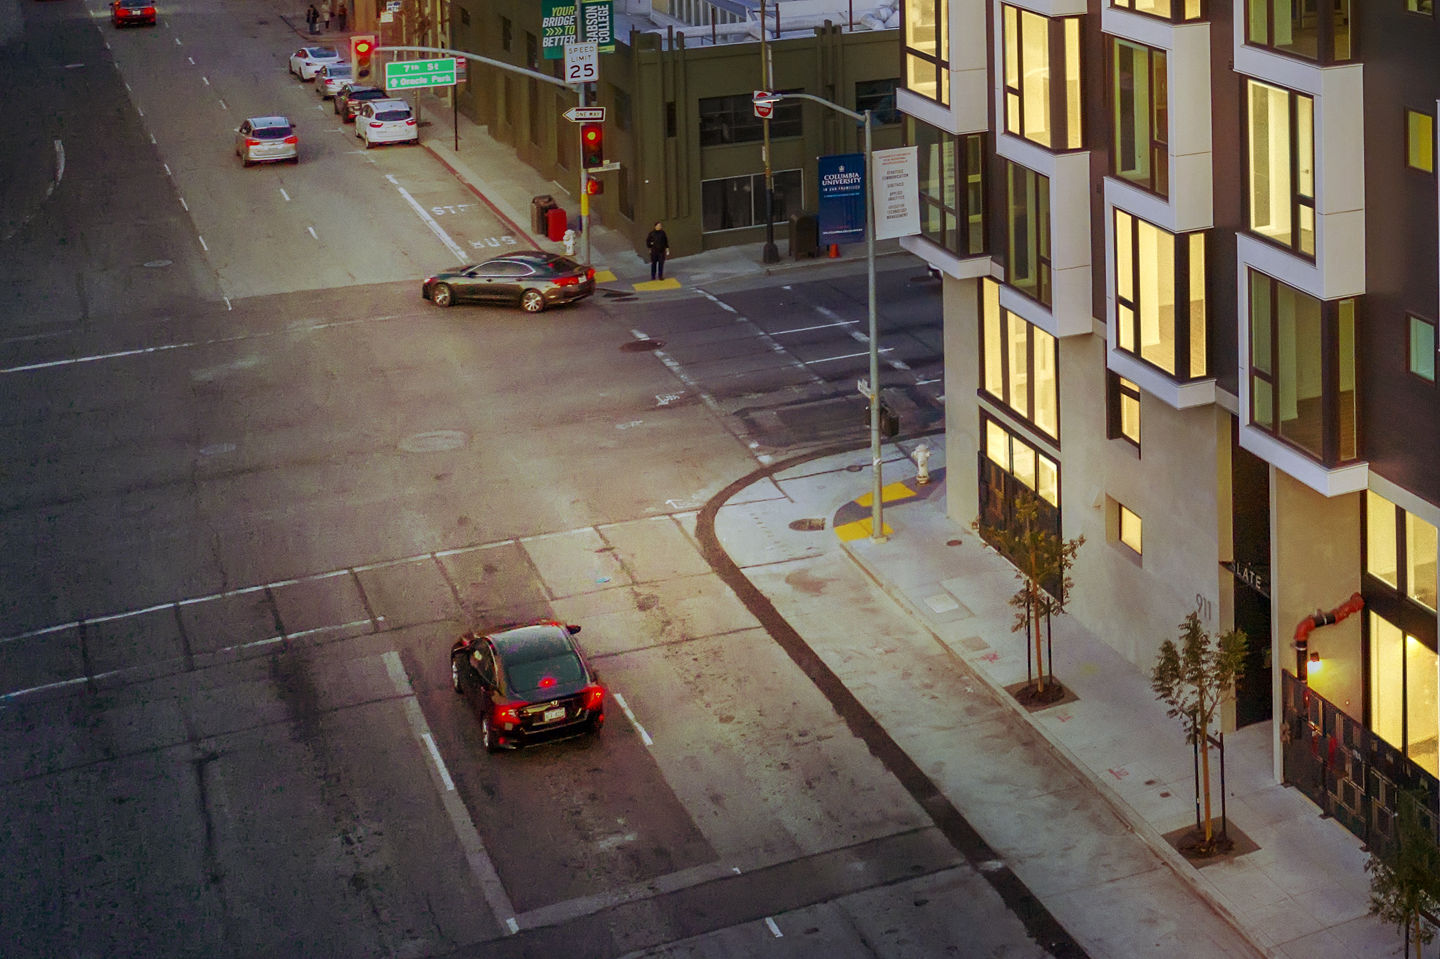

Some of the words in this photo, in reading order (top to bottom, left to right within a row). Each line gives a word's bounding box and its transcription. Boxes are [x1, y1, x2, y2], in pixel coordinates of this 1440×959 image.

[551, 6, 575, 17] YOUR
[542, 15, 576, 28] BRIDGE
[585, 6, 598, 43] BABSON
[598, 4, 610, 43] COLLEGE
[564, 25, 576, 35] TO
[542, 35, 576, 47] BETTER
[568, 46, 594, 54] SPEED
[427, 63, 439, 71] St
[570, 63, 594, 78] 25
[431, 74, 451, 84] Park
[822, 177, 862, 186] UNIVERSITY
[824, 172, 860, 181] COLUMBIA
[1196, 593, 1212, 621] 911
